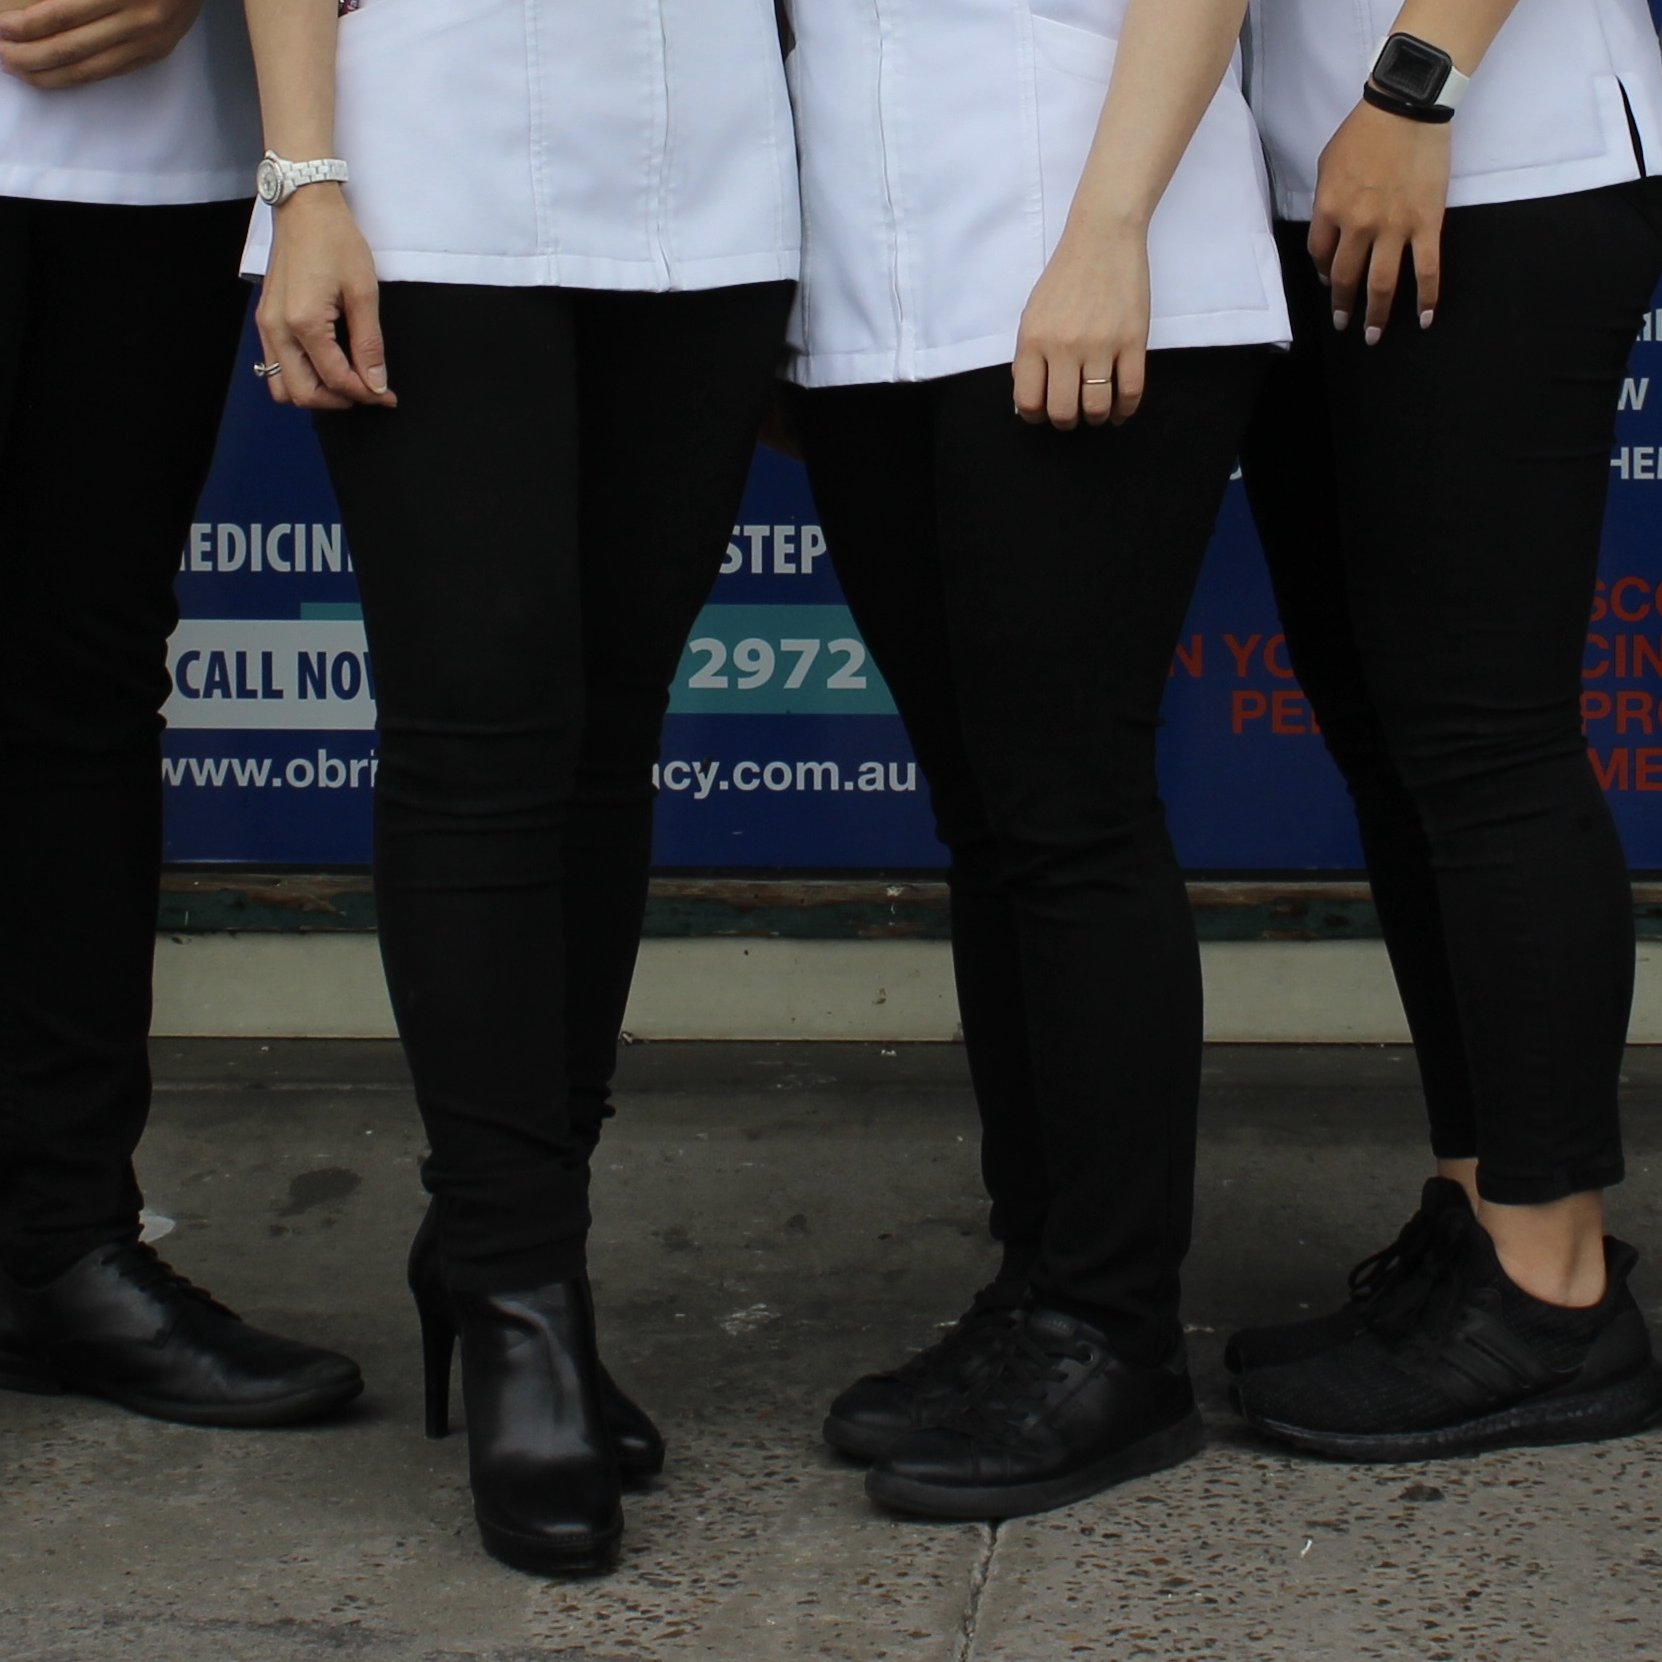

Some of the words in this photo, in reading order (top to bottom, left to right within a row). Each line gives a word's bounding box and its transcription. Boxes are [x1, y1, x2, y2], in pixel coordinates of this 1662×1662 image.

[179, 522, 355, 573] EDICIN
[175, 649, 284, 701] CALL
[687, 637, 867, 690] 2972
